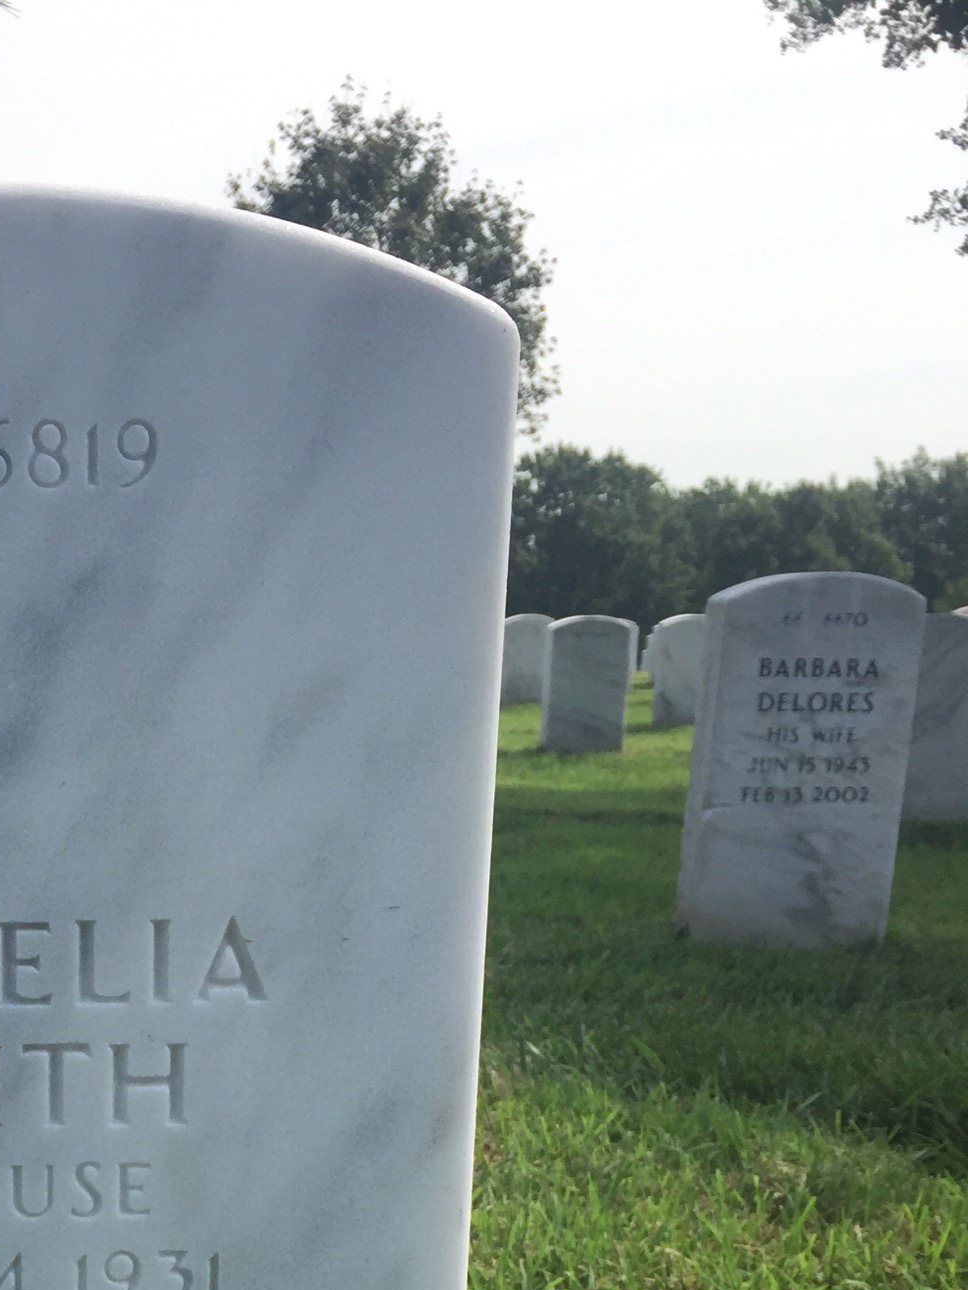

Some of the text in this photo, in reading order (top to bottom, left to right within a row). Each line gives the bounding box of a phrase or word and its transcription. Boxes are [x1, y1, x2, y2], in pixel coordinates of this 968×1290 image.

[759, 657, 879, 679] BARBARA
[757, 691, 875, 713] DELORES
[767, 726, 858, 744] HIS WIFE
[747, 756, 790, 774] JUN
[740, 786, 776, 804] FEB
[812, 786, 870, 804] 2002
